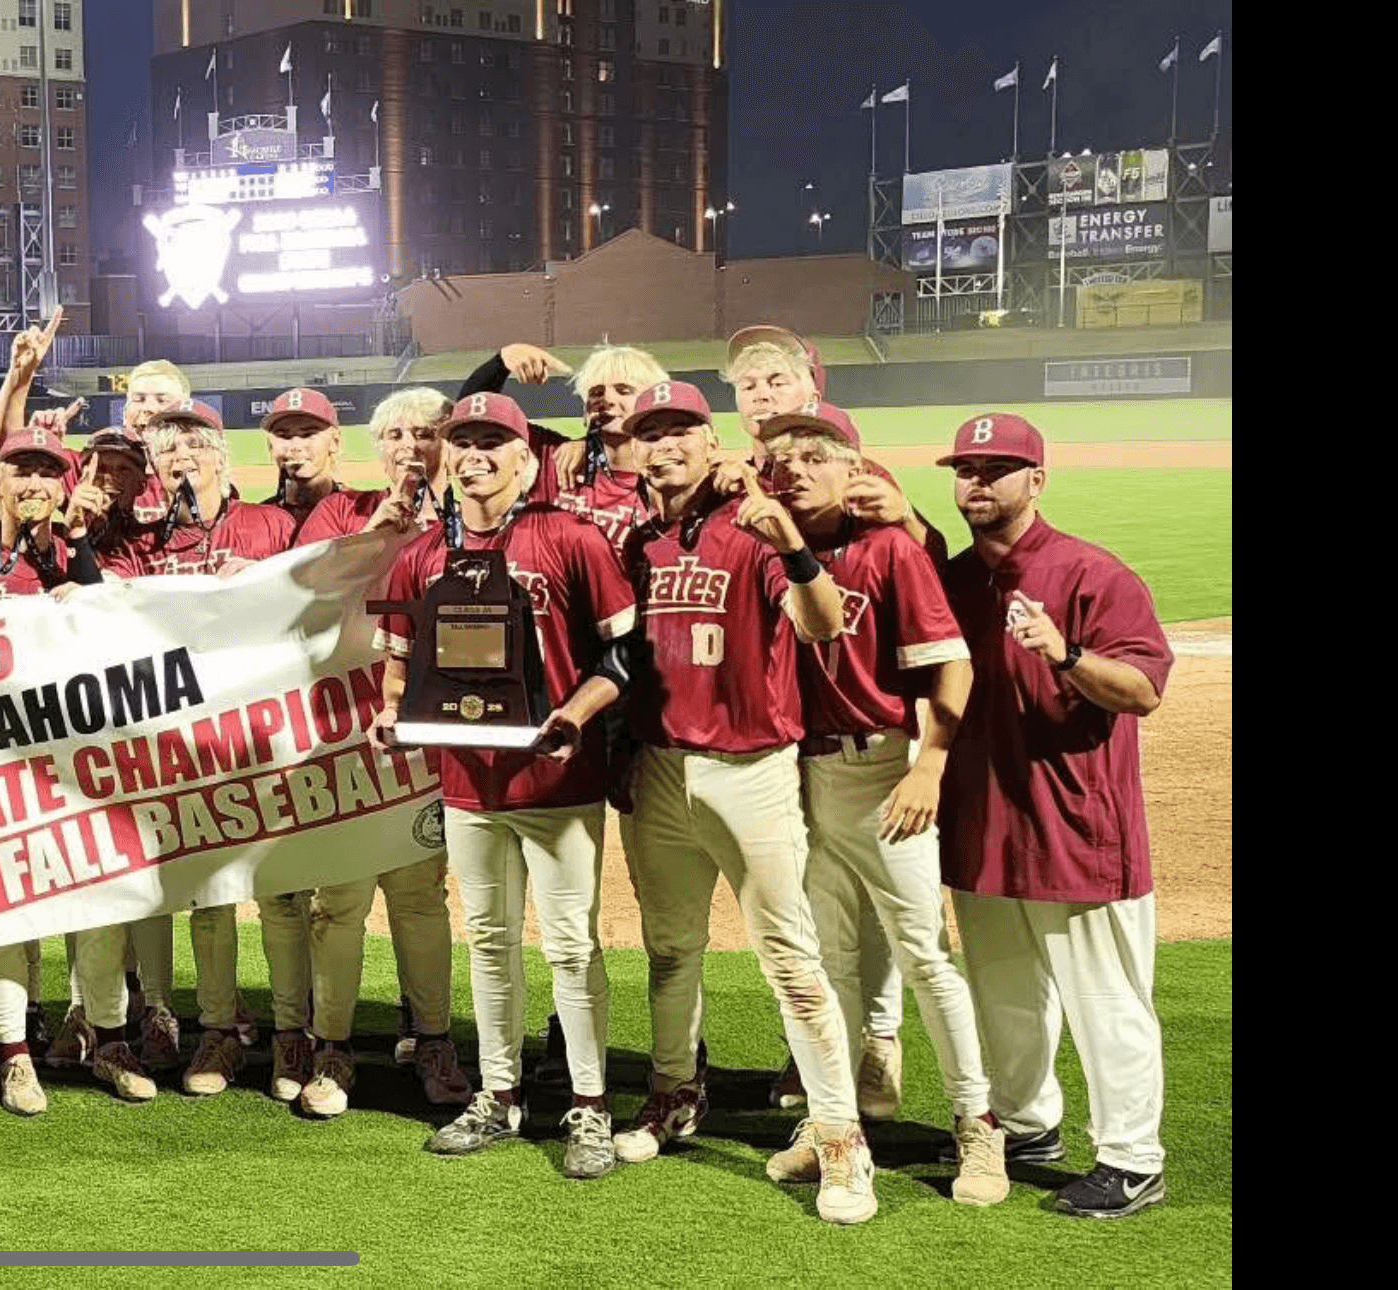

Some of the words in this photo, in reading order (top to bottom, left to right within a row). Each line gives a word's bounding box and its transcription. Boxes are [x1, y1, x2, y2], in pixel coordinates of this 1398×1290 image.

[1080, 208, 1147, 228] ENERGY
[1079, 223, 1164, 244] TRANSFER
[288, 390, 303, 411] B
[652, 383, 672, 405] B
[470, 395, 487, 415] B
[32, 428, 47, 446] B
[971, 418, 993, 444] B
[690, 622, 725, 667] 10
[72, 660, 386, 800] CHAMPION
[131, 747, 441, 862] BASEBALL
